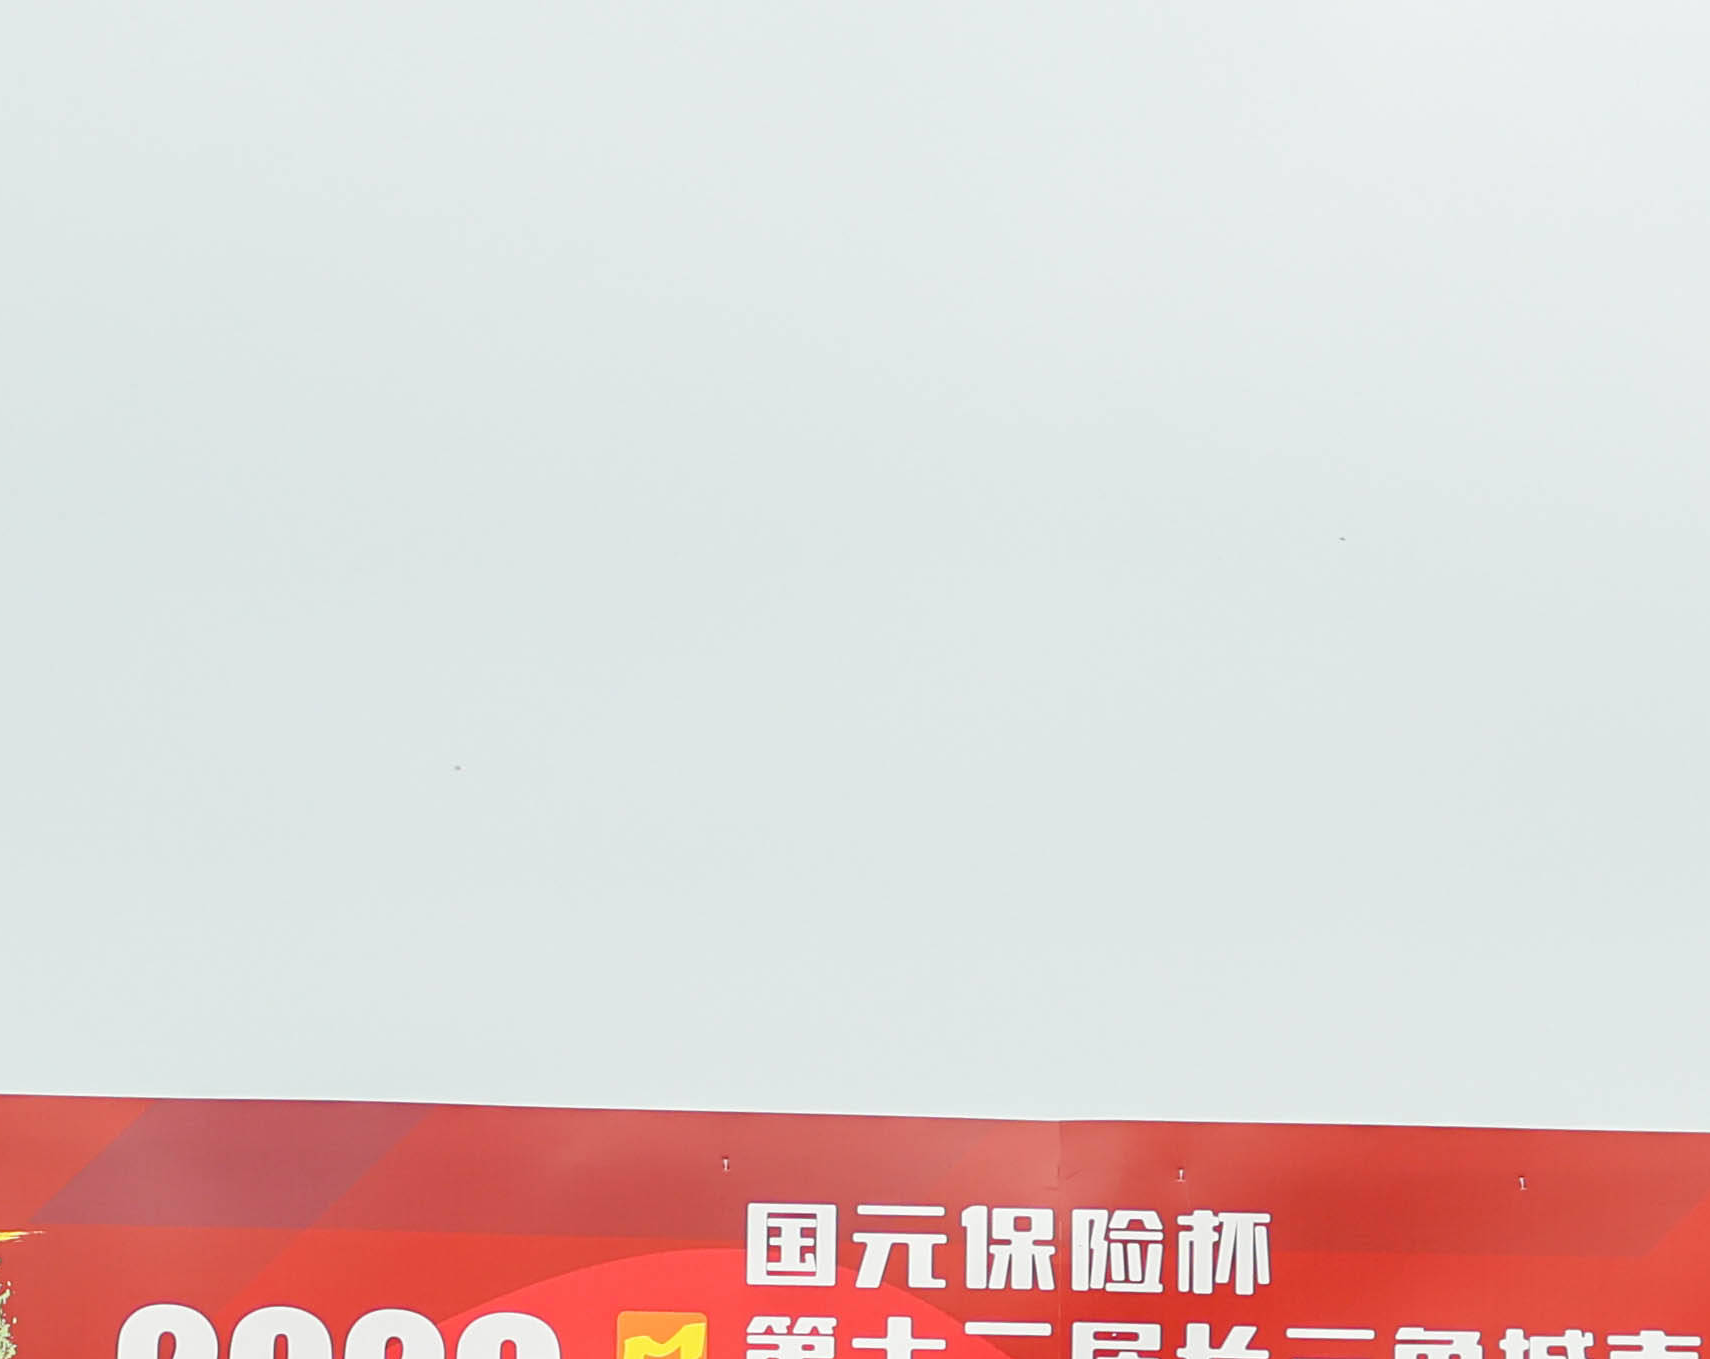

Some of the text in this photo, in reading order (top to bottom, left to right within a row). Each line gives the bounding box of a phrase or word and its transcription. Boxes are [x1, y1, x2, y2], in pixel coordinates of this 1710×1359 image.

[746, 1203, 1271, 1296] 国元保险杯
